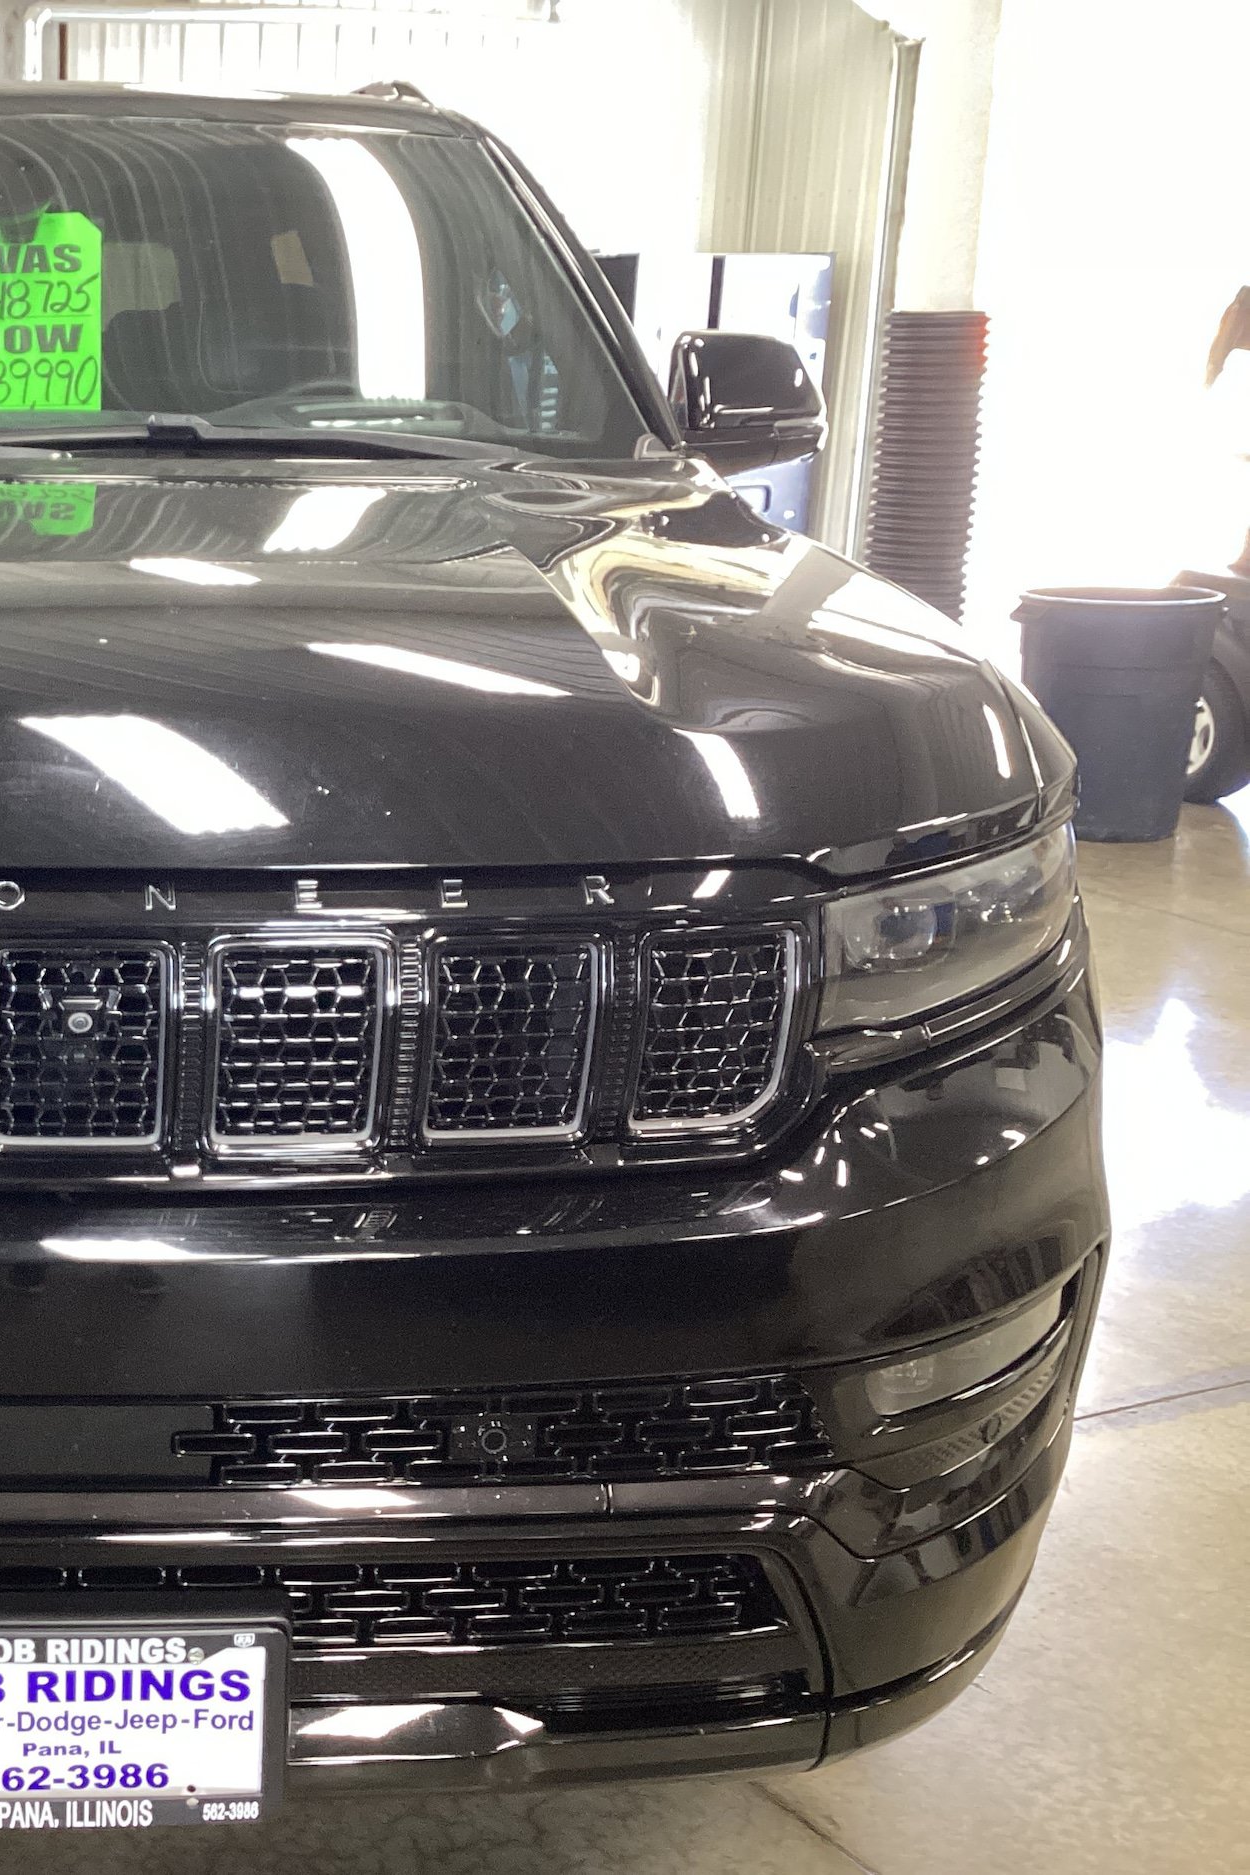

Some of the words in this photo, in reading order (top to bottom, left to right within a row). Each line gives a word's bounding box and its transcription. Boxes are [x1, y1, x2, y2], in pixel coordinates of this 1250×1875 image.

[46, 1637, 187, 1664] RIDINGS
[27, 1669, 251, 1703] RIDINGS
[22, 1742, 90, 1758] Pana,
[99, 1740, 122, 1754] IL
[65, 1799, 153, 1828] ILLINOIS
[202, 1801, 259, 1821] 562-3986
